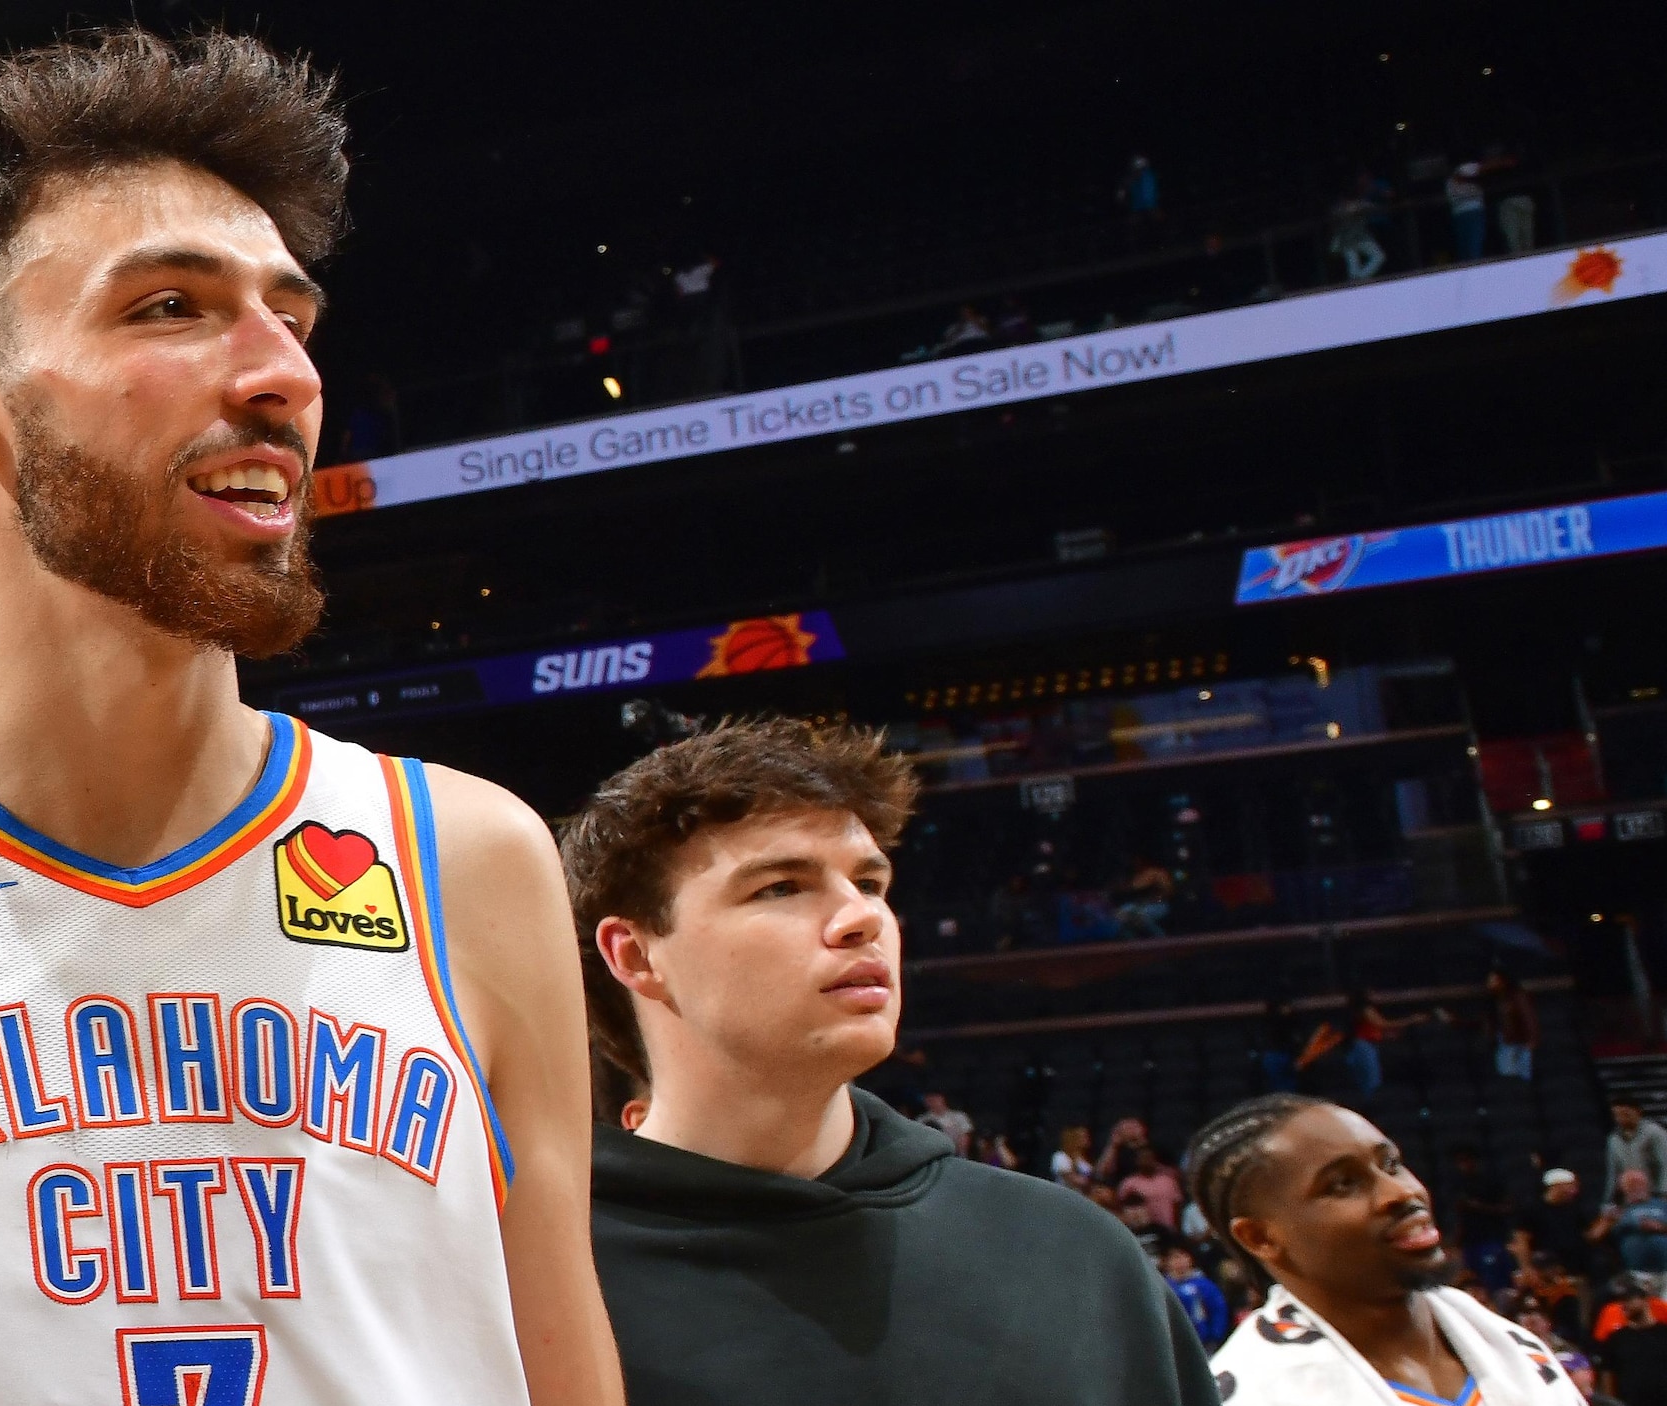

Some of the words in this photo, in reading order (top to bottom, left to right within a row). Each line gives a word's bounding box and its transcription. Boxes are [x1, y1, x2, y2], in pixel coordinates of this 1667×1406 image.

[459, 437, 578, 485] Single
[589, 418, 709, 462] Game
[721, 385, 869, 438] Tickets
[885, 378, 940, 413] on
[953, 359, 1049, 401] Sale
[1063, 332, 1176, 381] Now!
[1441, 506, 1594, 573] THUNDER
[531, 641, 652, 694] SUNS
[26, 1156, 306, 1305] CITY
